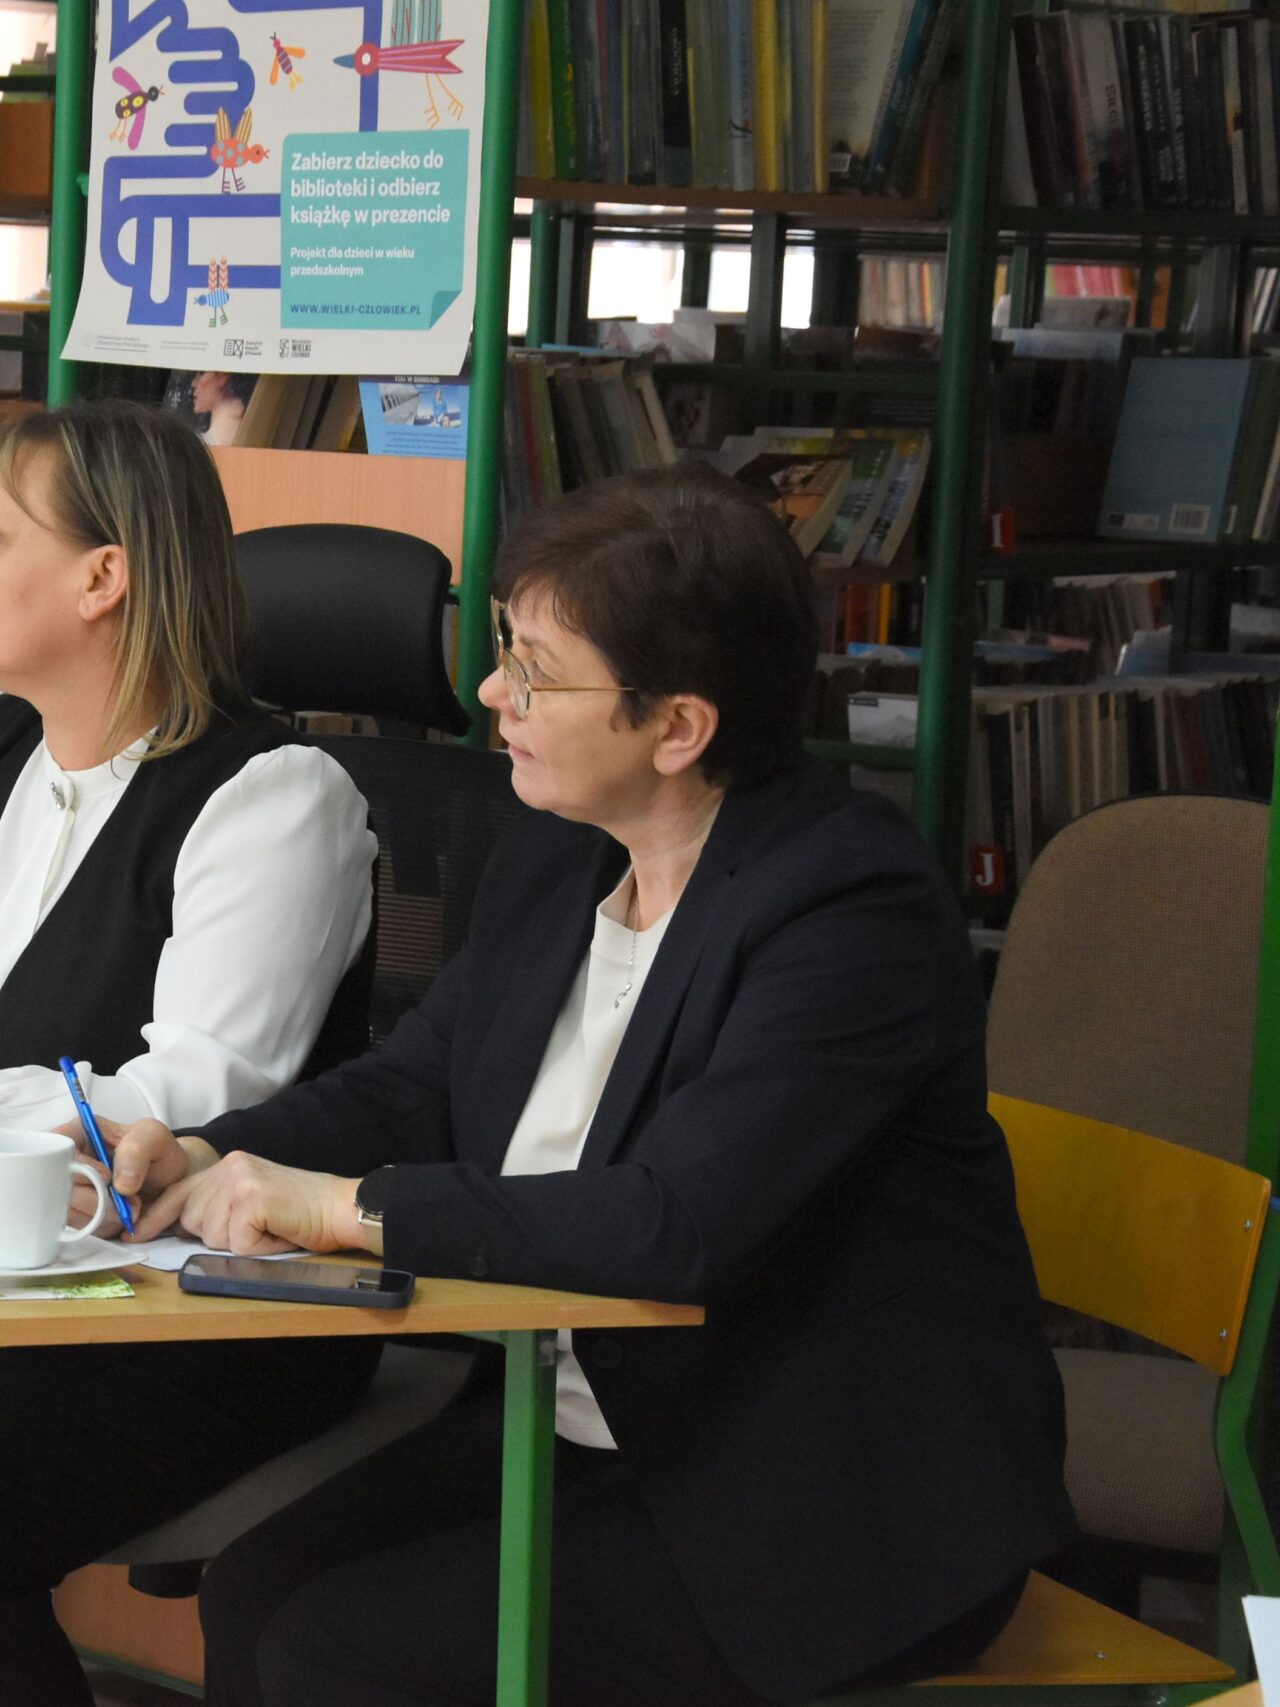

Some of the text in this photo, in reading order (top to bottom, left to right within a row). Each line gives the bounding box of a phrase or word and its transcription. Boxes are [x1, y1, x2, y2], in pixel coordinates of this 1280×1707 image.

[291, 149, 444, 170] Zabierz dziecko do
[290, 178, 440, 197] biblioteki i odbierz
[290, 204, 451, 228] książkę w prezencie
[290, 247, 415, 261] Projekt dla dzieci w wieku
[290, 264, 365, 278] przedszkolnym
[290, 303, 422, 316] WWW.WIELKI-CZLOWIEK.PL
[291, 343, 312, 352] WIELKI
[975, 852, 995, 887] J
